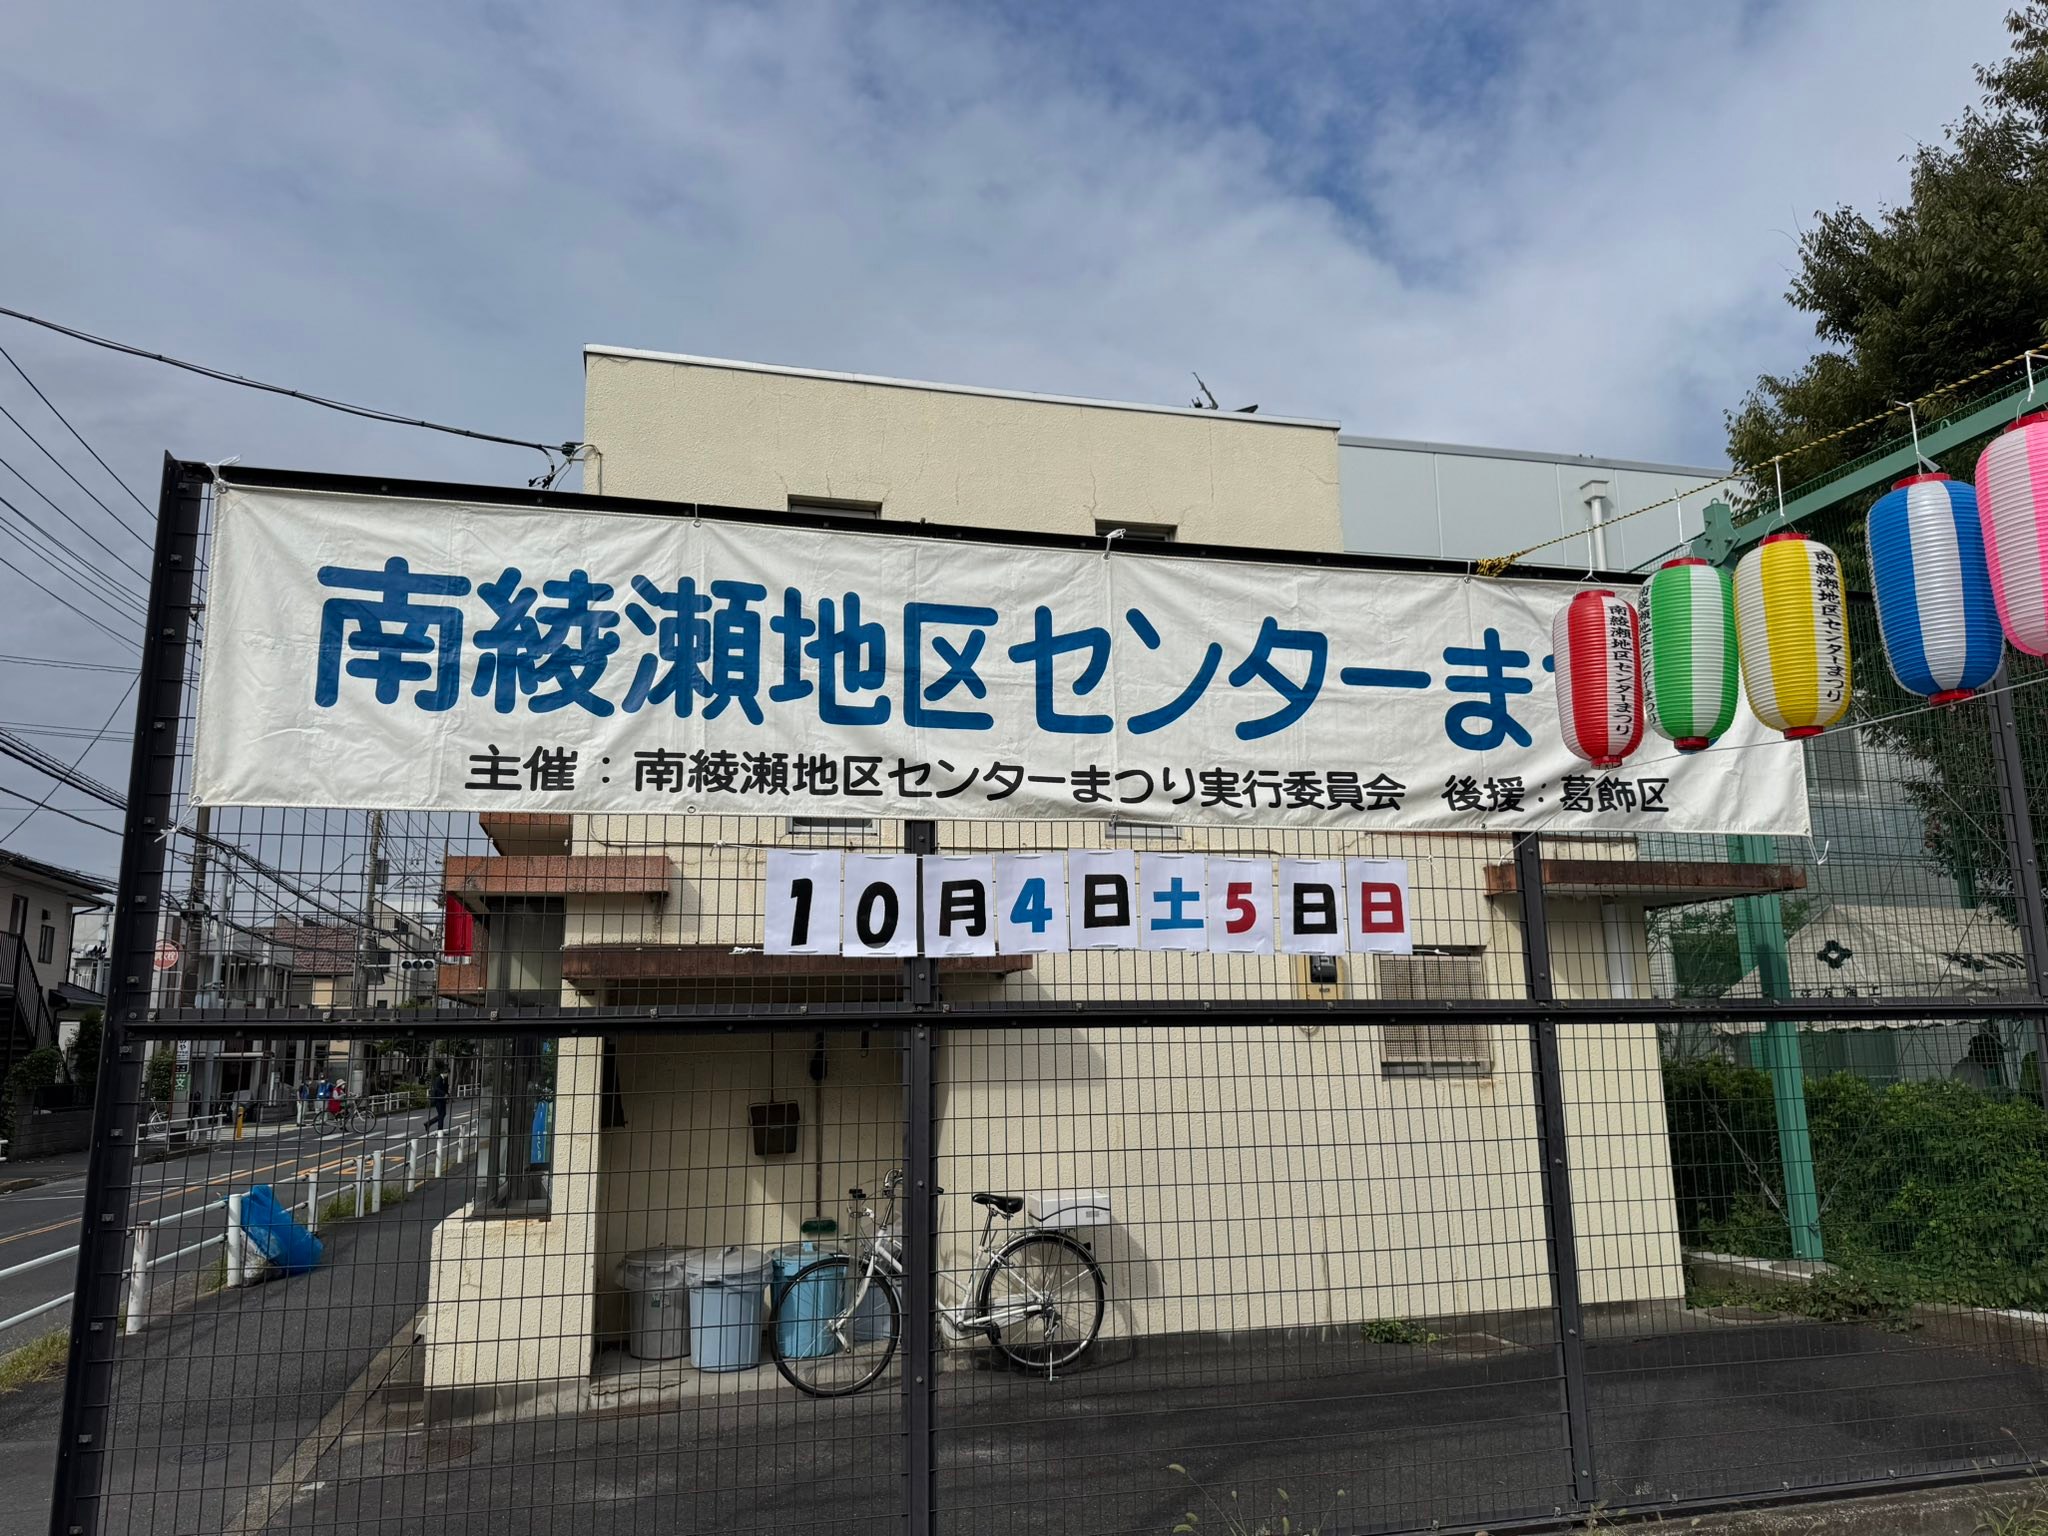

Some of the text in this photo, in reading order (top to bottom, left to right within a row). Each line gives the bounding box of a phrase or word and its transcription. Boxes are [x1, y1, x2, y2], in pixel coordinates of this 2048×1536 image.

[316, 556, 1556, 750] 南綾瀬地区センターま
[1608, 604, 1634, 736] 南綾瀬地区センターまつり
[1813, 550, 1845, 703] 南綾瀬地区センターまつり
